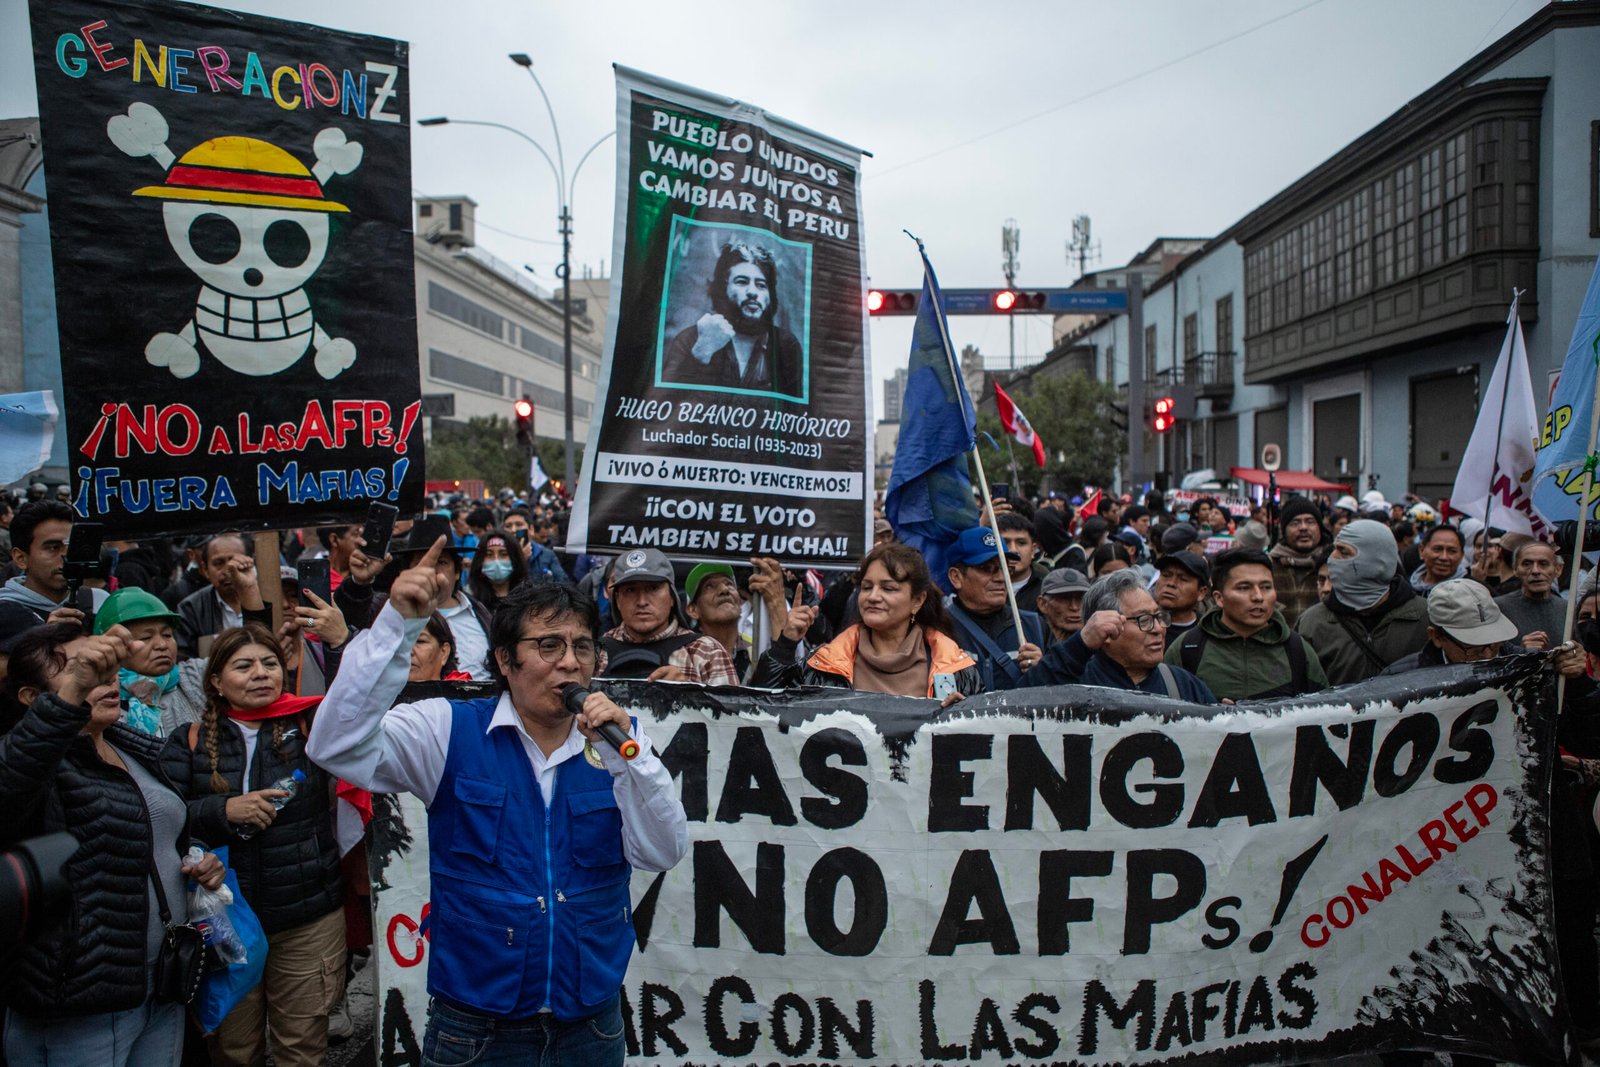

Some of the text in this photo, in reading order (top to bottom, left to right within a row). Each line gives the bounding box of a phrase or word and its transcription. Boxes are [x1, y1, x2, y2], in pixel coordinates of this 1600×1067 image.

[55, 20, 401, 123] GENERACION Z
[647, 140, 843, 214] VAMOS JUNTOS A
[652, 110, 839, 186] PUEBLO UNIDOS
[639, 170, 849, 240] CAMBIAR EL PERU
[80, 402, 201, 461] ¡NO
[208, 425, 233, 455] A
[616, 396, 851, 438] HUGO BLANCO HISTÓRICO
[642, 428, 823, 460] Luchador Social (1935-2023)
[73, 457, 410, 518] ¡FUERA MAFIAS!
[608, 459, 851, 493] ¡VIVO ó MUERTO: VENCEREMOS!
[608, 525, 848, 557] TAMBIEN SE LUCHA!!
[645, 496, 816, 528] ¡¡CON EL VOTO
[1300, 783, 1499, 949] CONALREP
[702, 974, 878, 1060] CON
[918, 979, 1062, 1061] LAS
[1078, 961, 1319, 1056] MAFIAS
